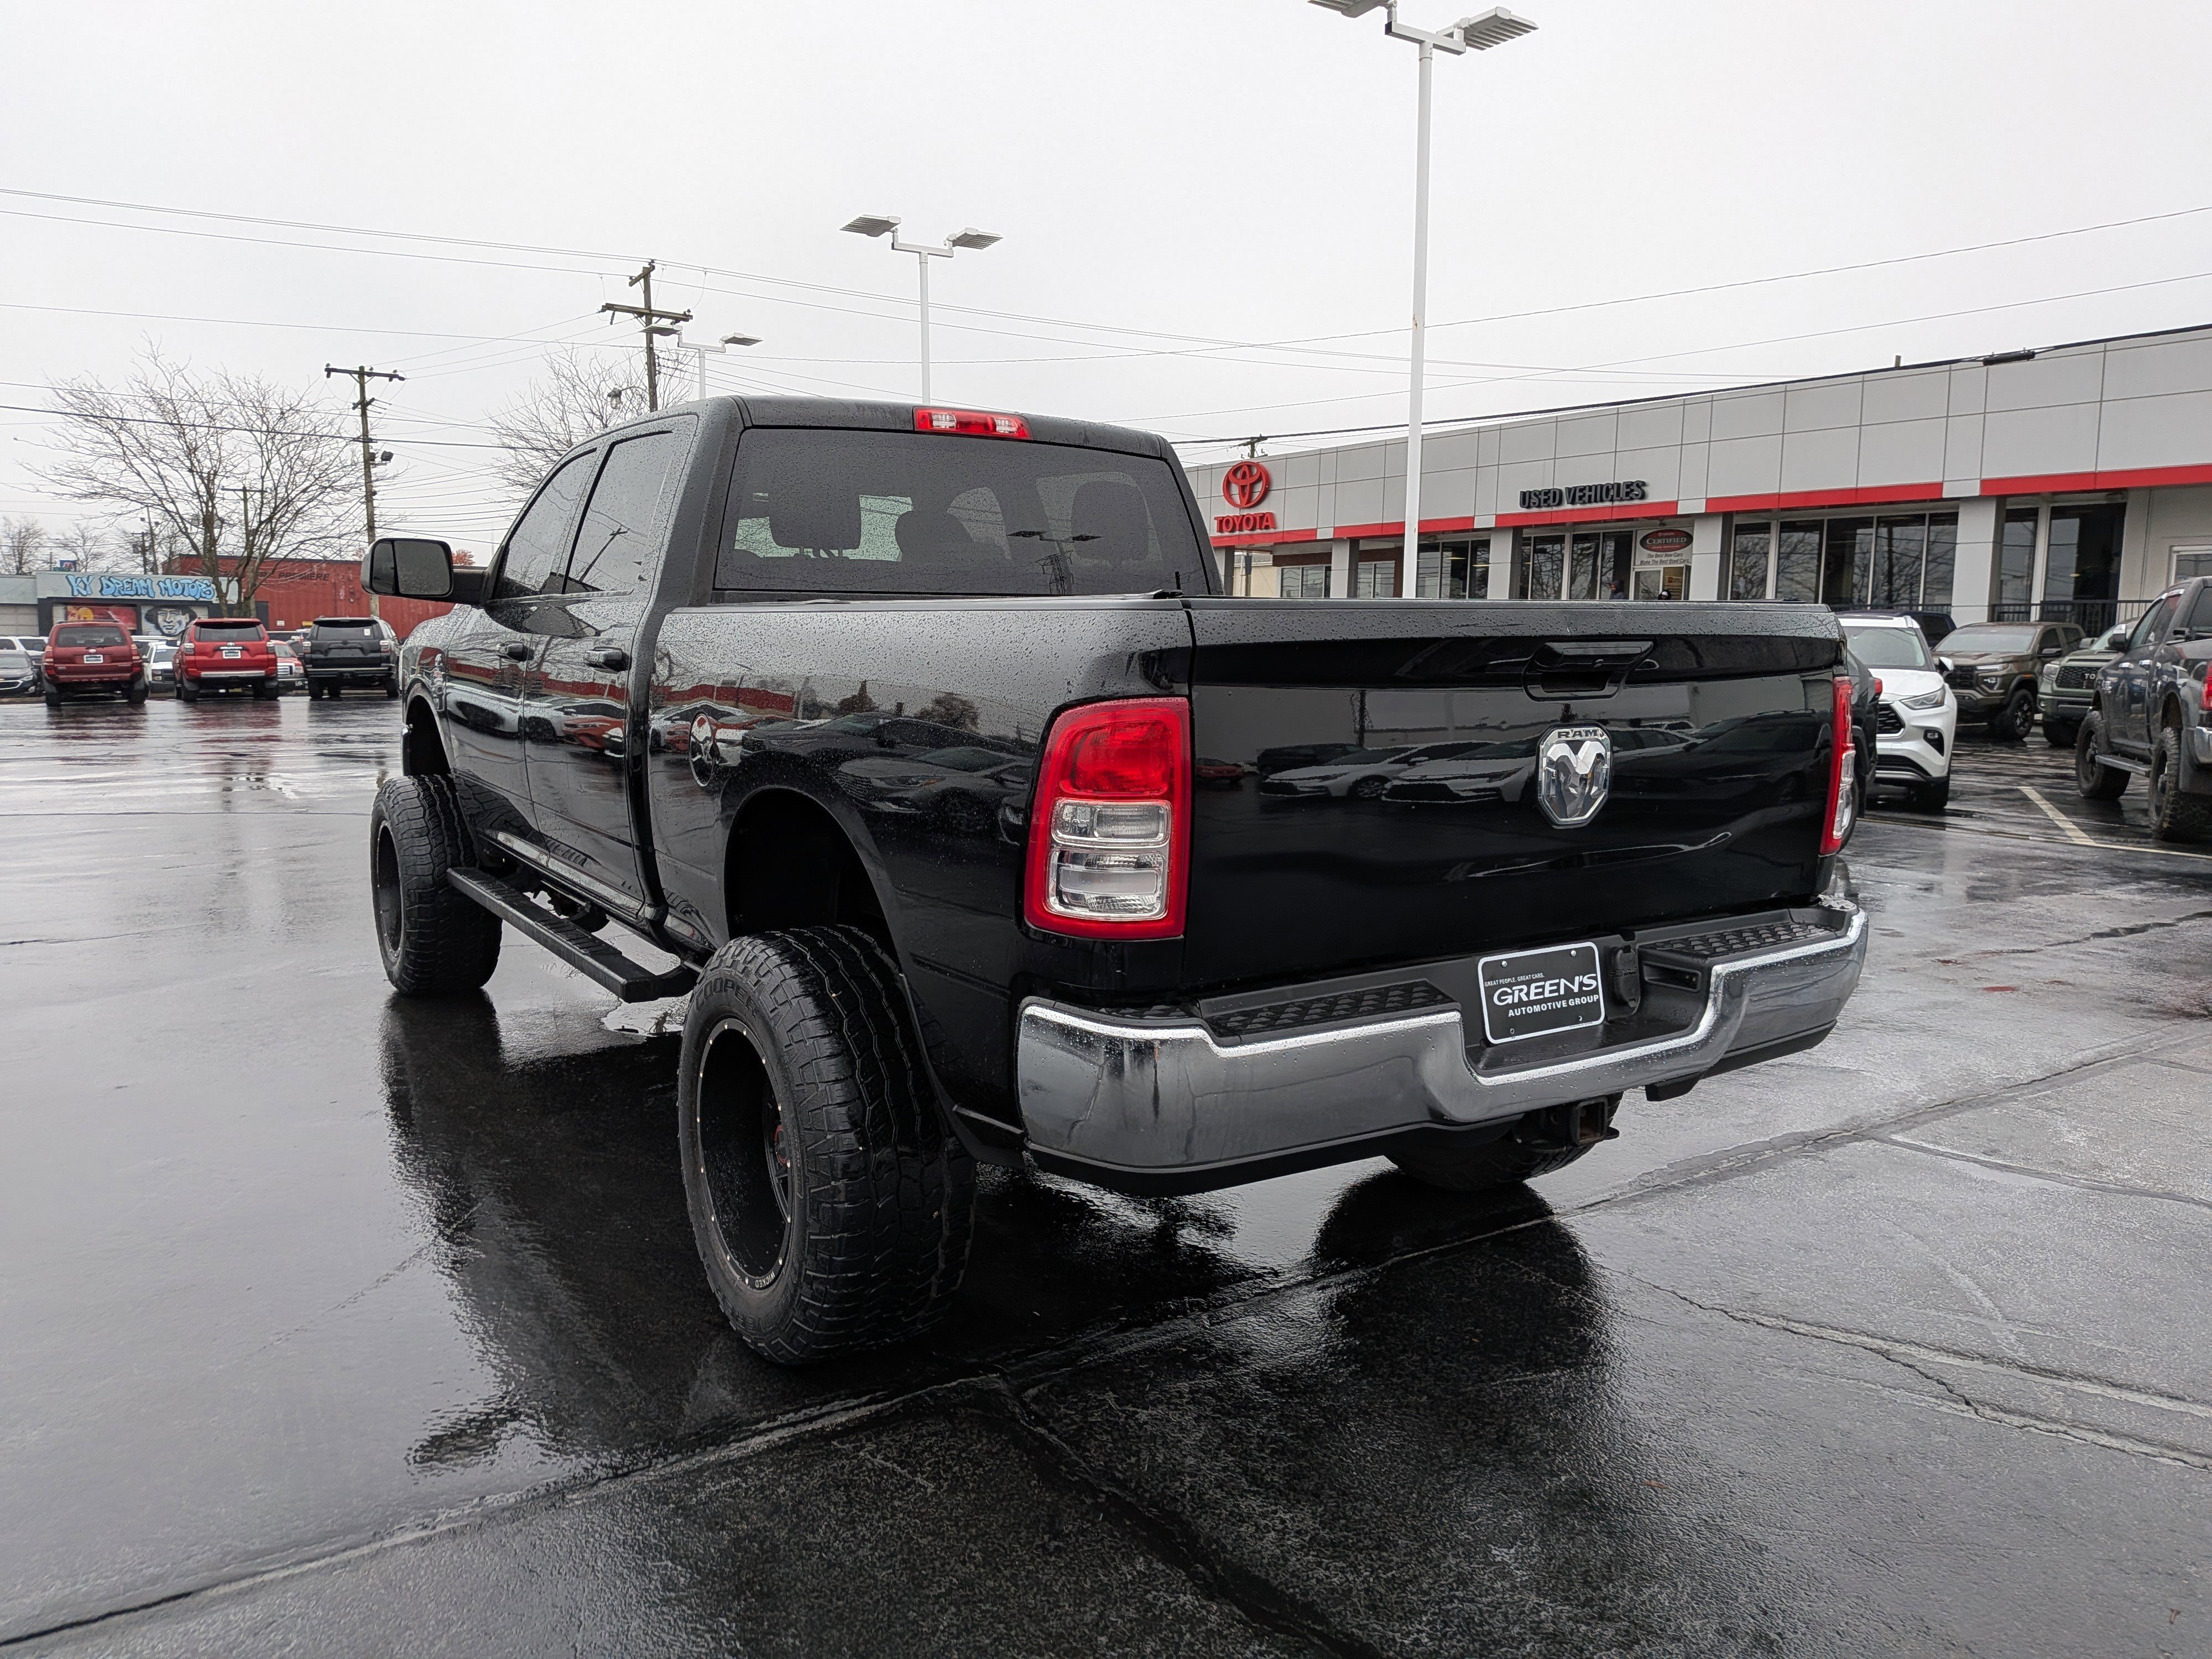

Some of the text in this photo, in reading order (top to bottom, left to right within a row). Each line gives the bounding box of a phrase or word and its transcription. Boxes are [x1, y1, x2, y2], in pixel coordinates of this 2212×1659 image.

[1520, 480, 1647, 509] USED VEHICLES
[1214, 512, 1277, 533] TOYOTA
[65, 575, 215, 600] KY DREAM MOTORS
[1557, 729, 1598, 739] RAM
[696, 977, 758, 1021] COOPER
[1493, 973, 1597, 1006] GREEN'S
[1508, 995, 1599, 1018] AUTOMOTIVE GROUP
[754, 1270, 775, 1288] WICKED
